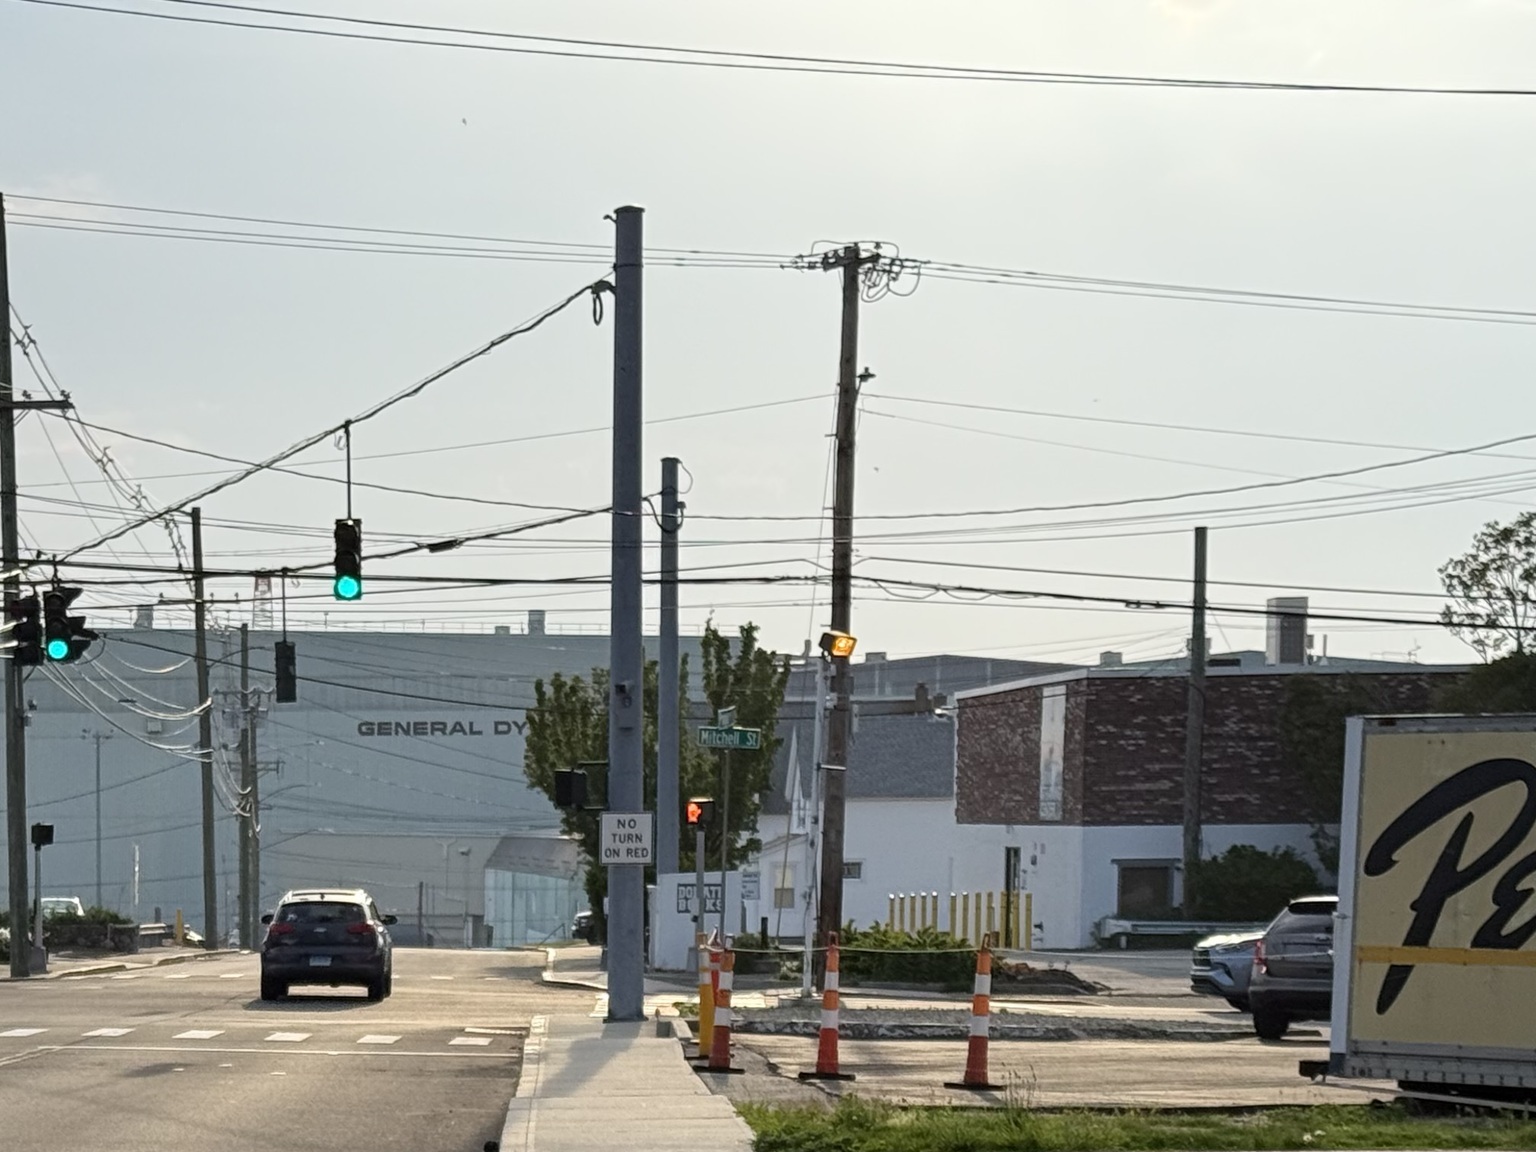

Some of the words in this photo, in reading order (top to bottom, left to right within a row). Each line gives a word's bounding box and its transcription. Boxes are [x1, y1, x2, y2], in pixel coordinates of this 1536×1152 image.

[357, 720, 483, 737] GENERAL
[700, 730, 741, 745] Mitchell
[617, 818, 637, 829] NO
[611, 833, 643, 844] TURN
[604, 847, 621, 859] ON
[626, 847, 649, 858] RED
